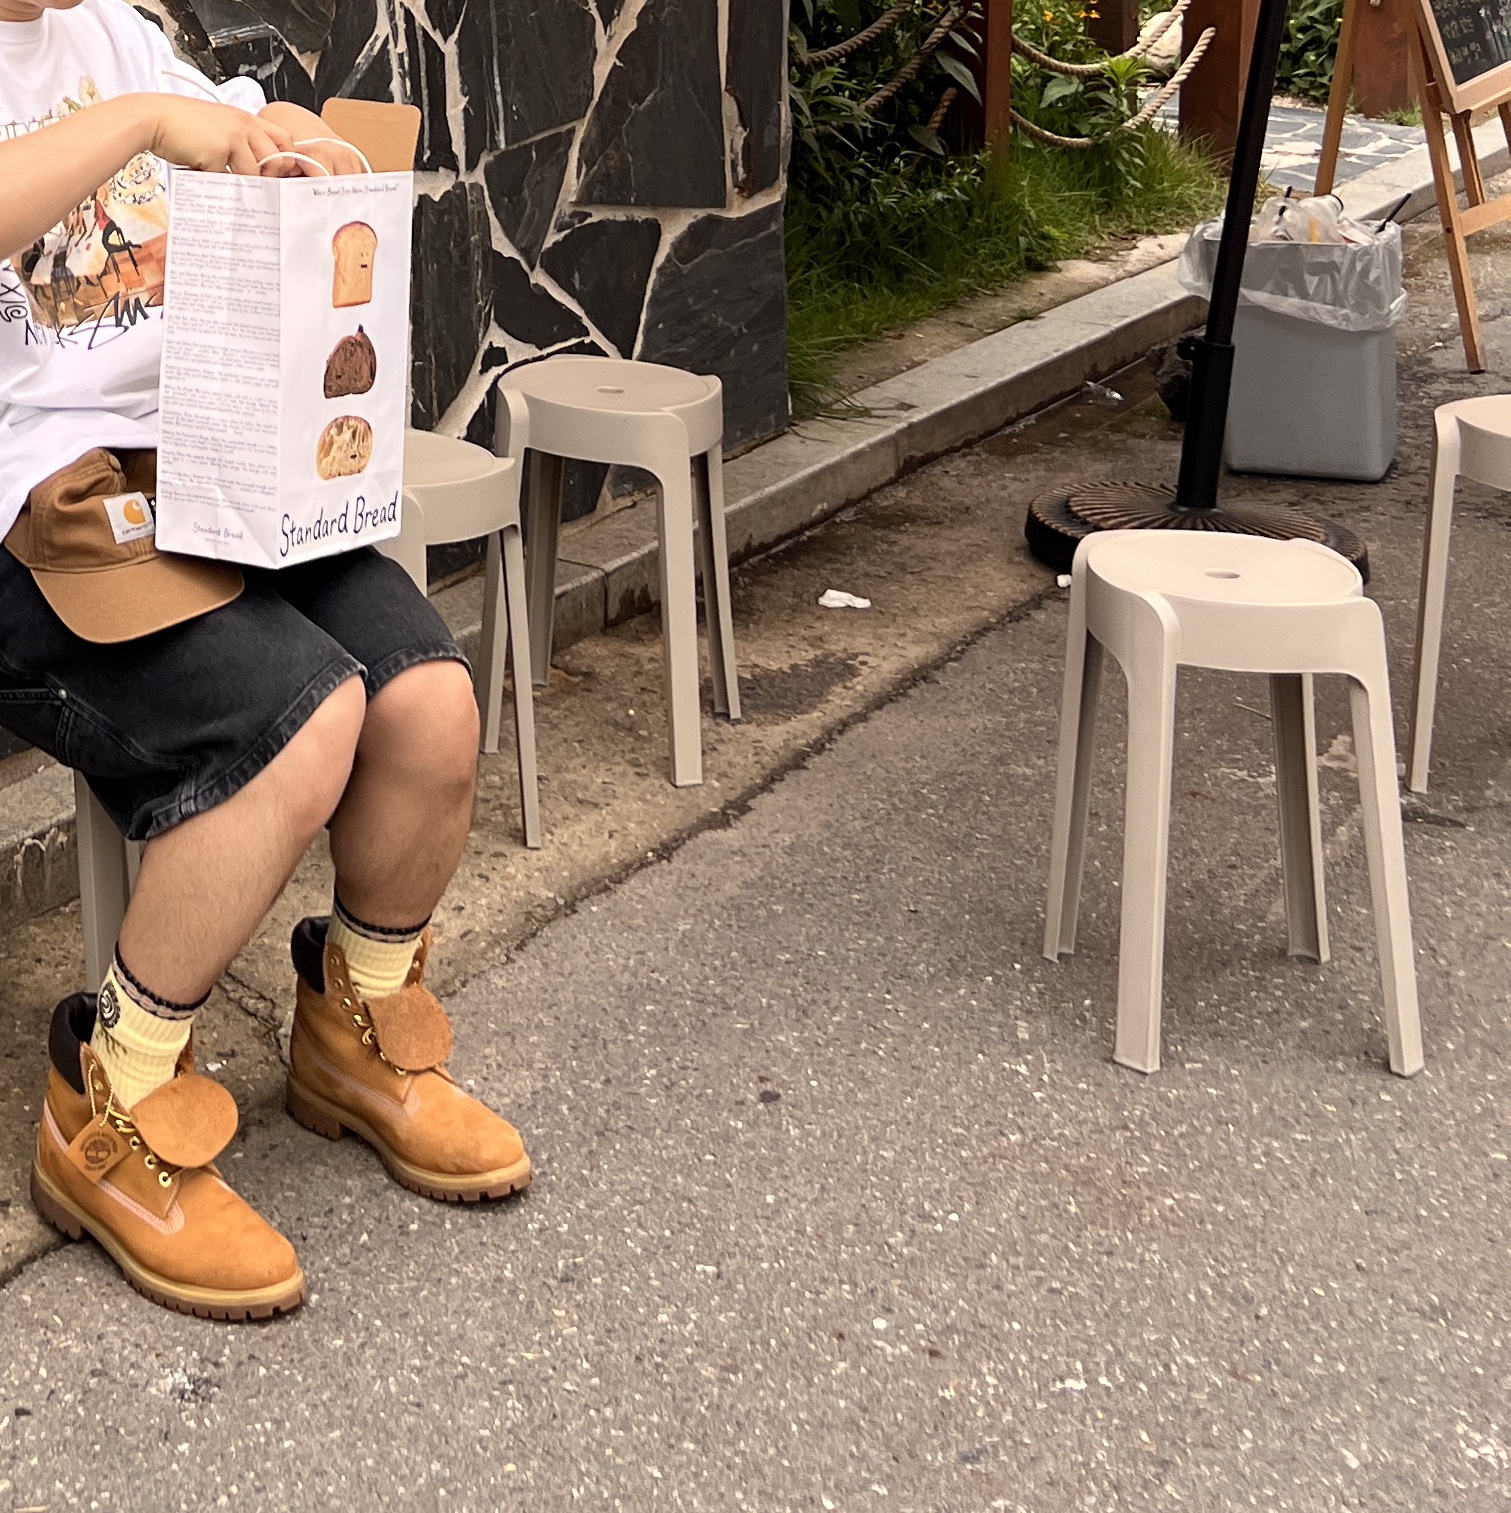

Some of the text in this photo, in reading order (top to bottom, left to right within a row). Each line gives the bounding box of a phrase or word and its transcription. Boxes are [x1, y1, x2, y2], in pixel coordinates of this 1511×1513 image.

[192, 521, 244, 540] Standard Bread
[279, 488, 399, 558] Standard Bread
